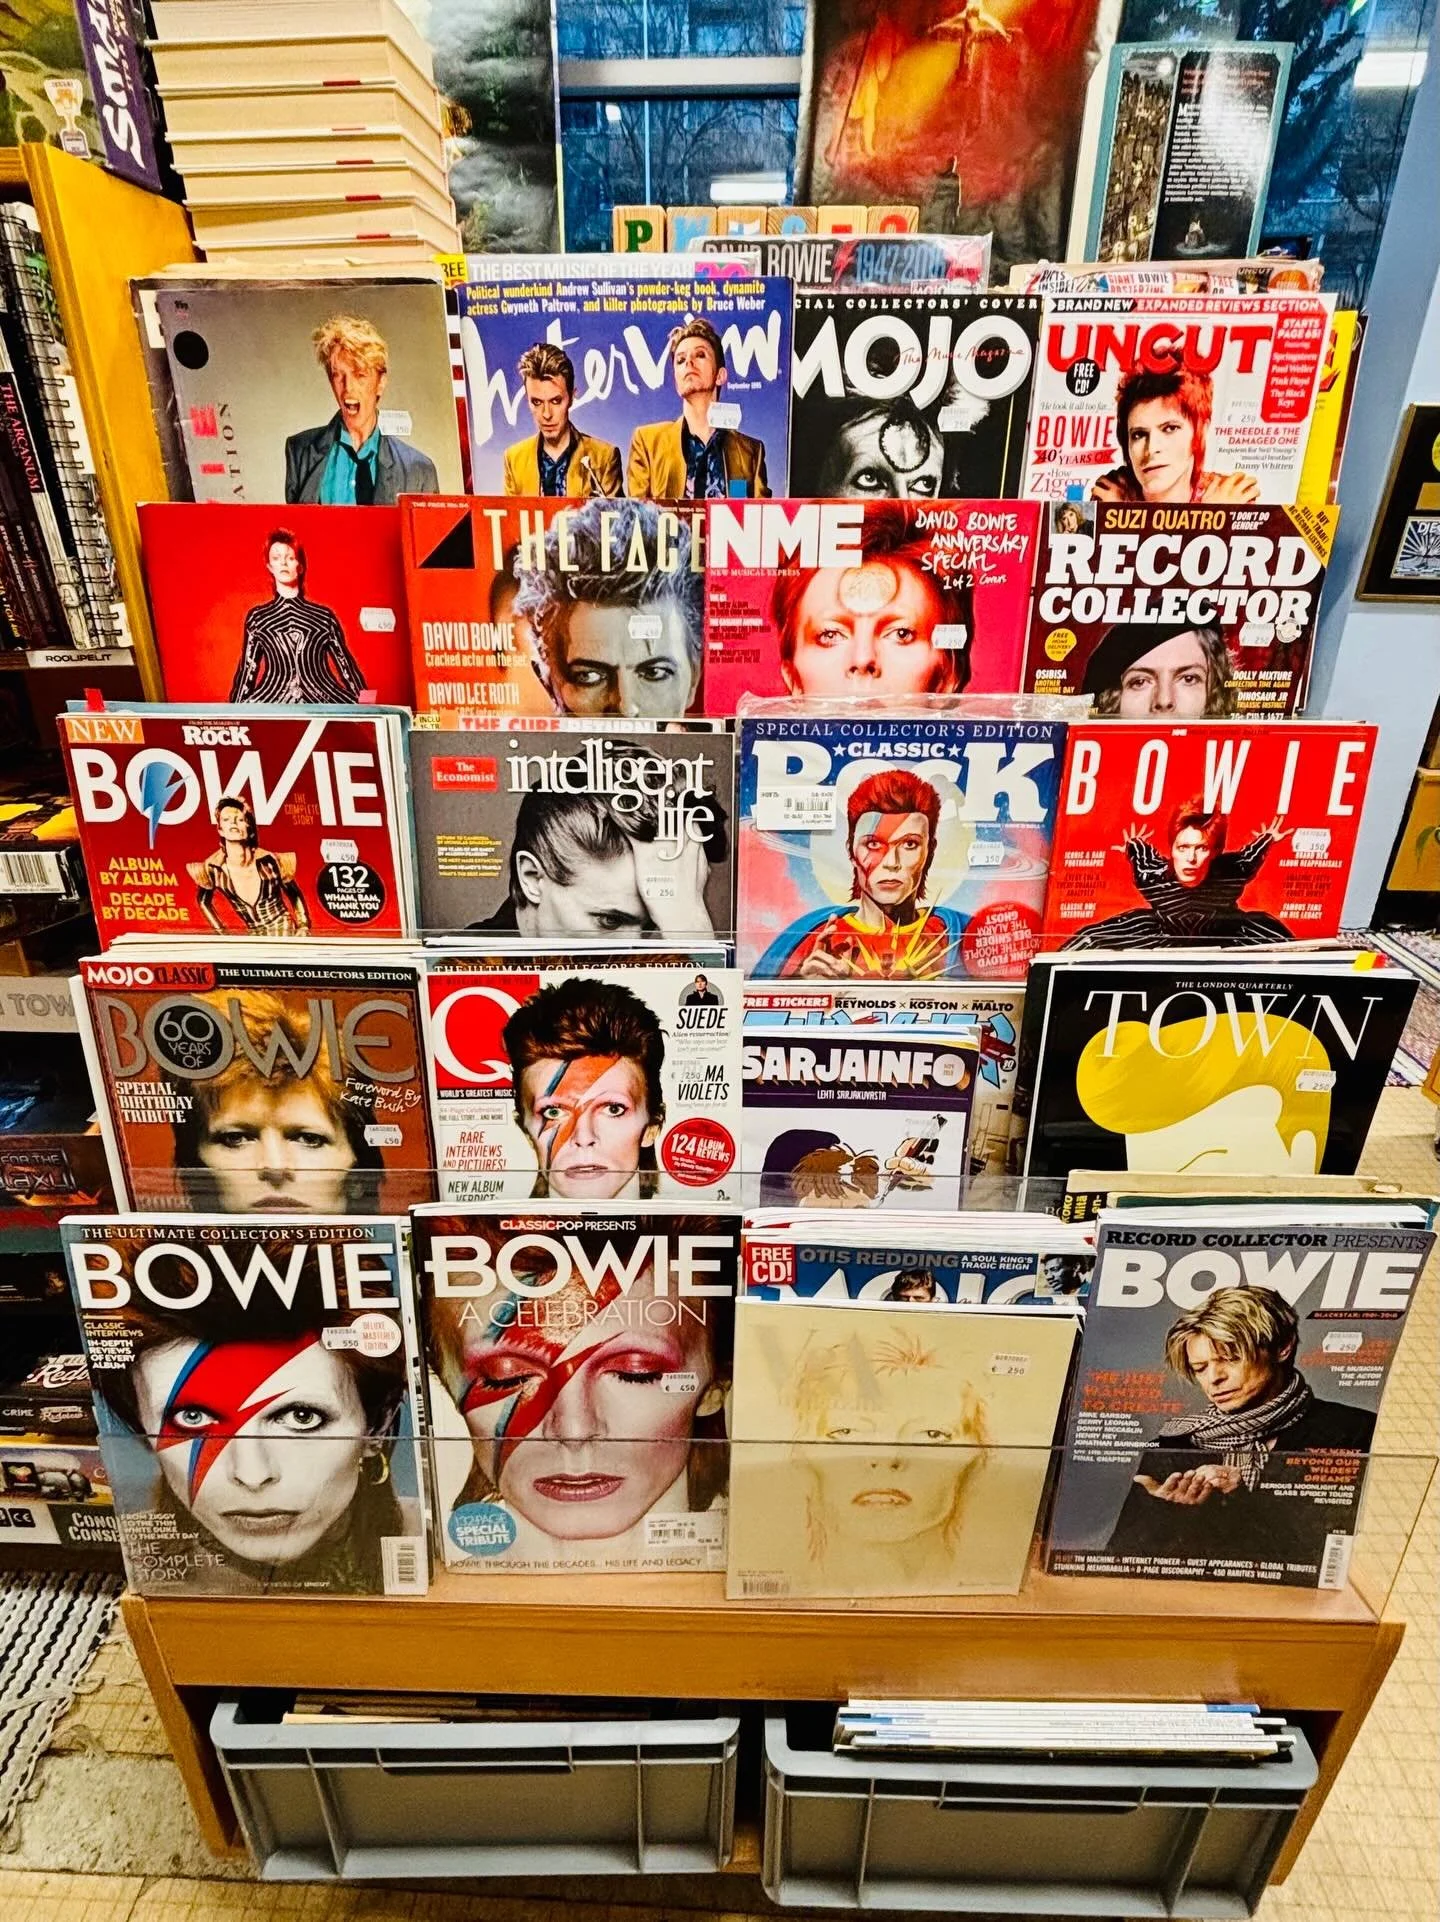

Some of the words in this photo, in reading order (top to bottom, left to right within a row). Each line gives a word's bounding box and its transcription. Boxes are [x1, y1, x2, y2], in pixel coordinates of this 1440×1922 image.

[466, 285, 500, 301] Political
[502, 284, 553, 299] wunderkind
[556, 282, 589, 297] Andrew
[591, 281, 635, 296] Sullivan's
[637, 282, 691, 298] powder-keg
[694, 281, 721, 296] book,
[722, 279, 766, 297] dynamite
[466, 302, 499, 316] actress
[501, 298, 539, 315] Gwyneth
[542, 298, 581, 314] Paltrow,
[583, 297, 600, 312] and
[603, 298, 628, 312] killer
[630, 297, 689, 313] photographs
[691, 297, 703, 313] by
[706, 297, 734, 312] Bruce
[736, 296, 767, 311] Weber
[845, 298, 970, 310] COLLECTORS'
[979, 298, 1039, 310] COVER
[1056, 297, 1102, 313] BRAND
[1103, 299, 1135, 312] NEW
[1137, 298, 1203, 313] EXPANDED
[1205, 299, 1261, 312] REVIEWS
[1262, 299, 1320, 312] SECTION
[1047, 322, 1275, 374] UNCUT
[793, 314, 1032, 411] MOJO
[1073, 362, 1095, 378] FREE
[460, 310, 782, 446] Intervw
[1074, 378, 1090, 395] CD!
[1, 383, 17, 416] THE
[1036, 415, 1116, 448] BOWIE
[1214, 426, 1233, 436] THE
[1234, 426, 1273, 436] NEEDLE
[1282, 427, 1301, 436] THE
[1228, 436, 1277, 445] DAMAGED
[1277, 436, 1299, 445] ONE
[8, 410, 43, 494] ARCANUM
[915, 509, 960, 532] DAVID
[966, 511, 1018, 532] BOWIE
[1104, 508, 1148, 530] SUZI
[1152, 509, 1226, 531] QUATRO
[1259, 512, 1270, 521] DO
[483, 509, 579, 573] THE
[599, 511, 706, 573] FACE
[709, 503, 865, 569] NME
[930, 533, 1029, 563] ANNIVERSARY
[921, 551, 997, 573] SPECIAL
[1045, 533, 1322, 587] RECORD
[952, 574, 964, 588] of
[965, 573, 975, 588] 2
[1038, 587, 1313, 626] COLLECTOR
[422, 622, 470, 651] DAVID
[470, 621, 517, 651] BOWIE
[45, 652, 113, 664] ROOLIPELIT
[1232, 670, 1257, 681] DOLLY
[1257, 670, 1293, 681] MIXTURE
[428, 682, 466, 704] DAVID
[466, 683, 488, 704] LEE
[489, 683, 520, 704] ROTH
[69, 719, 139, 743] NEW
[181, 725, 252, 746] ROCK
[755, 723, 834, 736] SPECIAL
[840, 724, 966, 737] COLLECTOR'S
[972, 725, 1055, 738] EDITION
[846, 742, 946, 758] CLASSIC
[70, 717, 384, 827] BOWIE
[455, 761, 475, 772] The
[507, 737, 715, 813] intelligent
[436, 770, 496, 783] Economist
[1065, 738, 1367, 817] BOWIE
[653, 787, 715, 861] life
[108, 856, 164, 872] ALBUM
[100, 872, 121, 886] BY
[122, 873, 179, 887] ALBUM
[328, 865, 370, 889] 132
[110, 892, 176, 907] DECADE
[102, 906, 125, 920] BY
[125, 906, 191, 921] DECADE
[87, 965, 155, 987] MOJO
[153, 968, 209, 985] CLASSIC
[217, 967, 239, 978] THE
[242, 968, 295, 979] ULTIMATE
[295, 969, 366, 980] COLLECTORS
[367, 971, 413, 982] EDITION
[1175, 980, 1194, 989] THE
[1196, 981, 1237, 990] LONDON
[1238, 981, 1294, 991] QUARTERLY
[772, 997, 830, 1008] STICKERS
[834, 999, 897, 1010] REYNOLDS
[909, 1000, 958, 1011] KOSTON
[971, 1002, 1014, 1012] MALTO
[159, 1010, 215, 1042] 60
[675, 1007, 729, 1030] SUEDE
[1083, 990, 1384, 1063] TOWN
[96, 994, 417, 1083] BOWIE
[430, 985, 521, 1083] Q
[168, 1041, 212, 1056] YEARS
[182, 1054, 205, 1068] OF
[741, 1045, 966, 1088] SARJAINFO
[115, 1081, 177, 1097] SPECIAL
[345, 1076, 403, 1099] Foreword
[404, 1090, 422, 1108] By
[677, 1082, 730, 1101] VIOLETS
[817, 1090, 835, 1101] LEHTI
[836, 1090, 887, 1101] SARJAKUVASTA
[119, 1095, 194, 1111] BIRTHDAY
[340, 1091, 372, 1108] Kate
[375, 1097, 407, 1114] Bush
[122, 1109, 187, 1124] TRIBUTE
[459, 1130, 486, 1144] RARE
[671, 1133, 698, 1157] 124
[699, 1139, 726, 1152] ALBUM
[445, 1145, 503, 1158] INTERVIEWS
[697, 1148, 731, 1164] REVIEWS
[447, 1180, 470, 1193] NEW
[470, 1180, 505, 1193] ALBUM
[81, 1227, 114, 1240] THE
[117, 1228, 197, 1240] ULTIMATE
[199, 1228, 306, 1240] COLLECTOR'S
[308, 1228, 375, 1239] EDITION
[584, 1220, 637, 1231] PRESENTS
[1105, 1230, 1197, 1247] RECORD
[1201, 1232, 1328, 1249] COLLECTOR
[1331, 1234, 1429, 1250] PRESENTS
[751, 1246, 793, 1263] FREE
[799, 1248, 851, 1264] OTIS
[855, 1250, 960, 1269] REDDING
[960, 1255, 971, 1263] A
[971, 1255, 998, 1263] SOUL
[999, 1256, 1034, 1265] KING'S
[423, 1233, 736, 1299] BOWIE
[751, 1262, 794, 1284] CD!
[960, 1263, 997, 1271] TRAGIC
[998, 1263, 1031, 1271] REIGN
[69, 1242, 400, 1311] BOWIE
[1095, 1247, 1423, 1310] BOWIE
[457, 1301, 485, 1328] A
[488, 1300, 708, 1328] CELEBRATION
[83, 1322, 126, 1330] CLASSIC
[85, 1329, 144, 1338] INTERVIEWS
[342, 1338, 359, 1348] 550
[454, 1524, 510, 1537] SPECIAL
[456, 1534, 512, 1547] TRIBUTE
